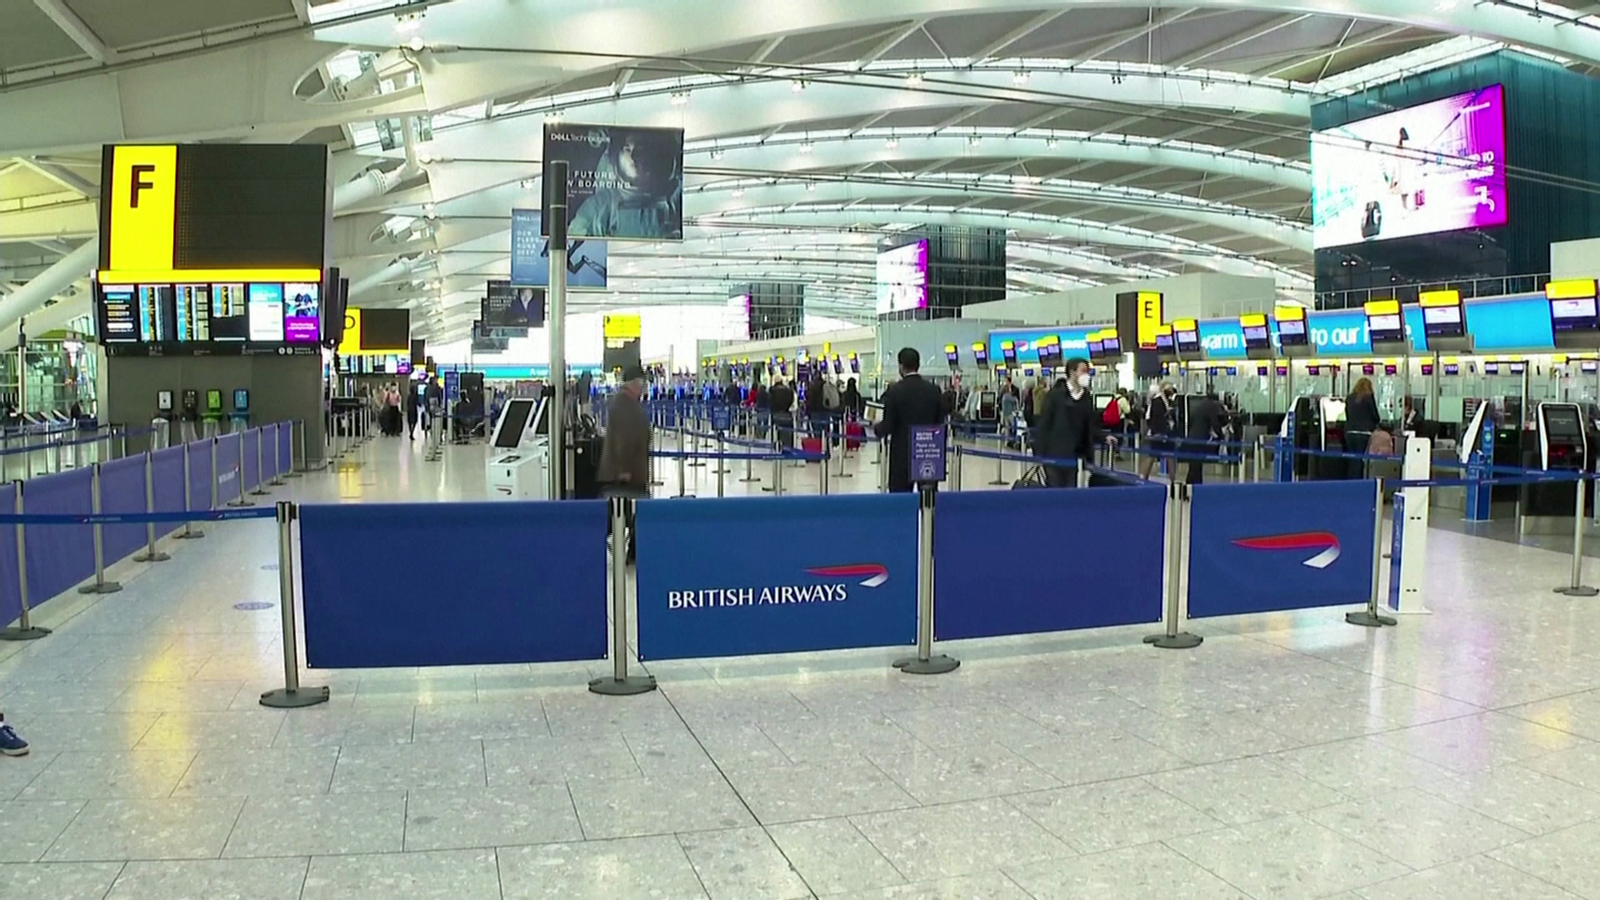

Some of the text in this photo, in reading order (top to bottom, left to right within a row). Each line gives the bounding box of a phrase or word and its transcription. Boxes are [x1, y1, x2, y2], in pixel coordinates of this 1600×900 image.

[130, 164, 155, 208] F
[1144, 300, 1154, 319] E
[1310, 327, 1328, 346] to
[1331, 327, 1360, 346] our
[668, 583, 847, 609] BRITISH AIRWAYS
